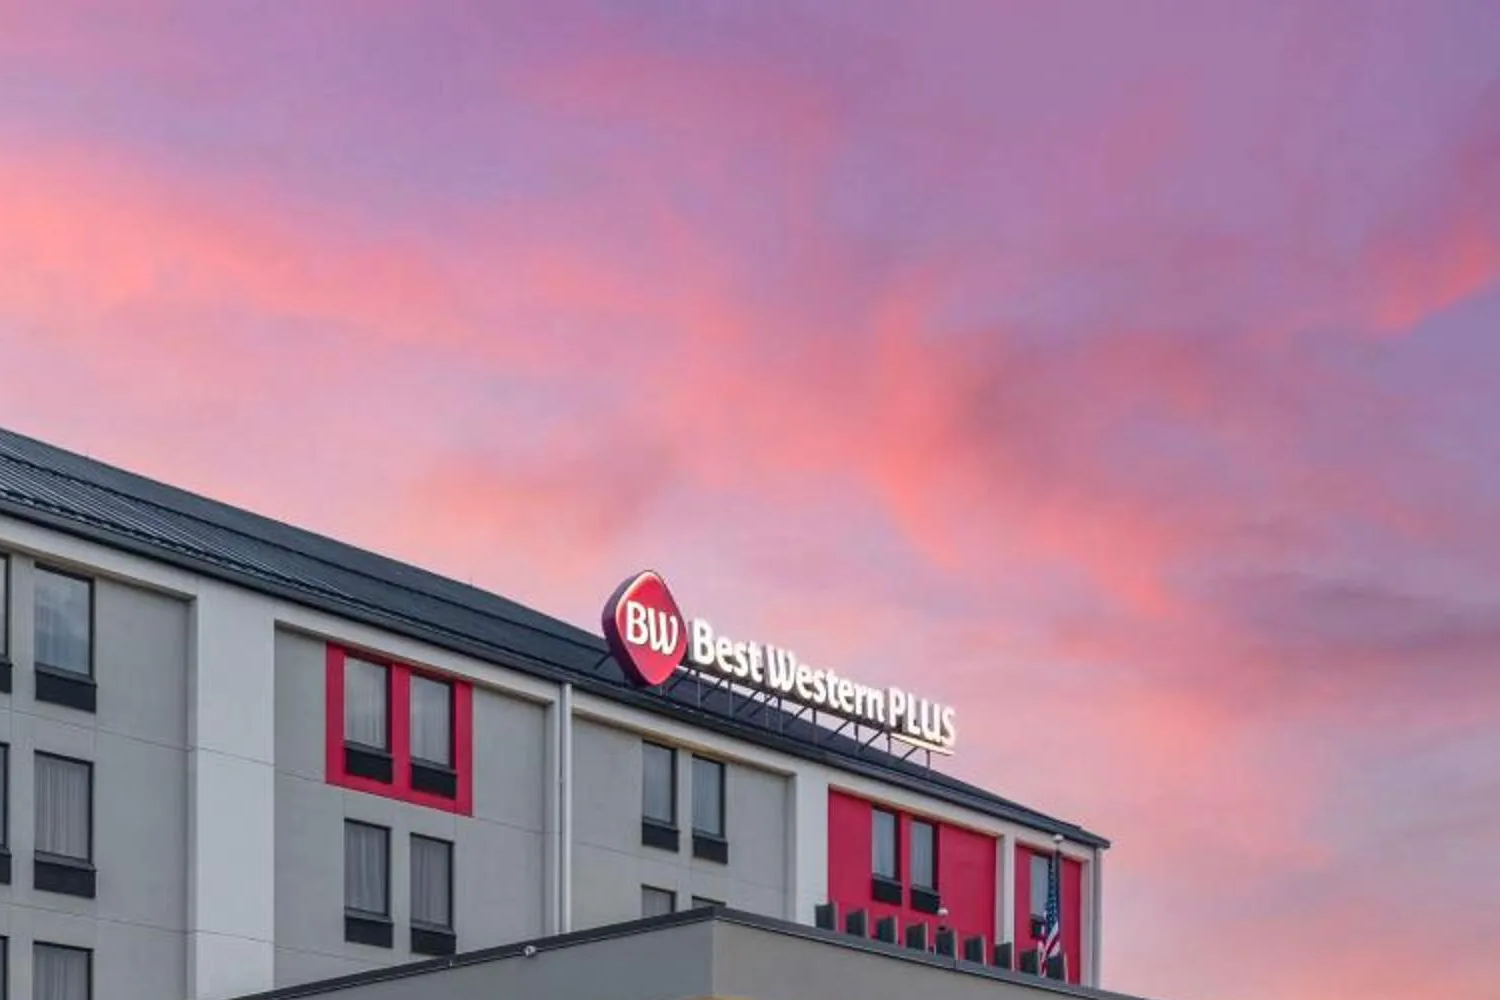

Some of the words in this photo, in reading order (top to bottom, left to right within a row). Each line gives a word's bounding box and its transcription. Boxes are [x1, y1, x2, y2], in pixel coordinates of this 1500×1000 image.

[627, 601, 678, 655] BW
[693, 618, 763, 683] Best
[765, 644, 885, 722] Western
[888, 686, 956, 746] PLUS
